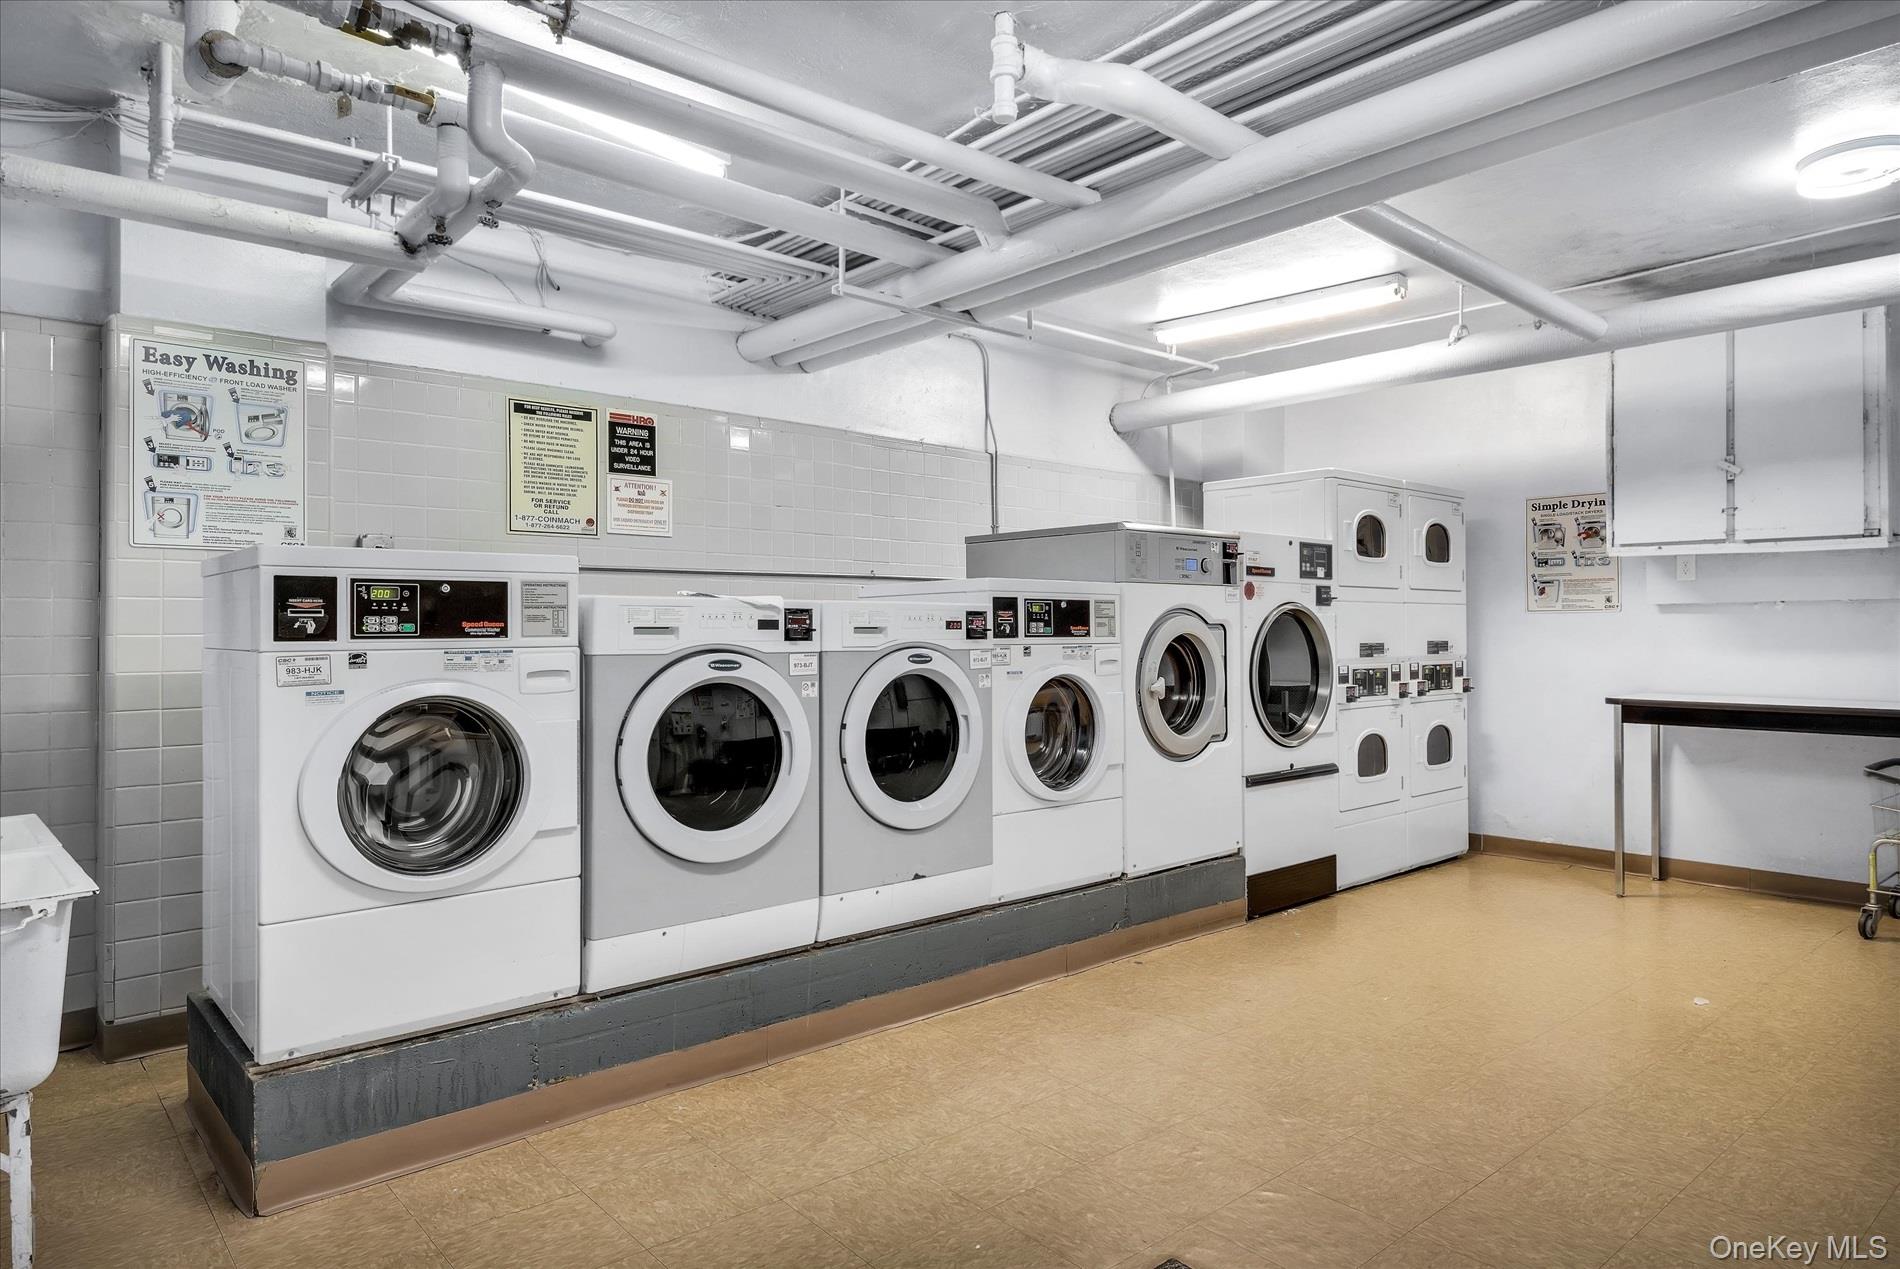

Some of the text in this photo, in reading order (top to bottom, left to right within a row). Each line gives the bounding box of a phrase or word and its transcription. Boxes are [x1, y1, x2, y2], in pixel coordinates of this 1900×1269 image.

[142, 346, 197, 373] Easy
[203, 354, 298, 385] Washing
[142, 369, 207, 381] HIGH-EFFICIENCY
[220, 378, 243, 386] FRONT
[268, 384, 297, 392] WASHER
[616, 426, 648, 437] WARNING
[614, 463, 651, 471] SURVEILLANCE
[624, 482, 653, 491] ATTENTION
[1531, 498, 1606, 512] Simple Dryin
[515, 515, 580, 524] 1-877-COINMACH
[286, 666, 322, 675] 983-HJK
